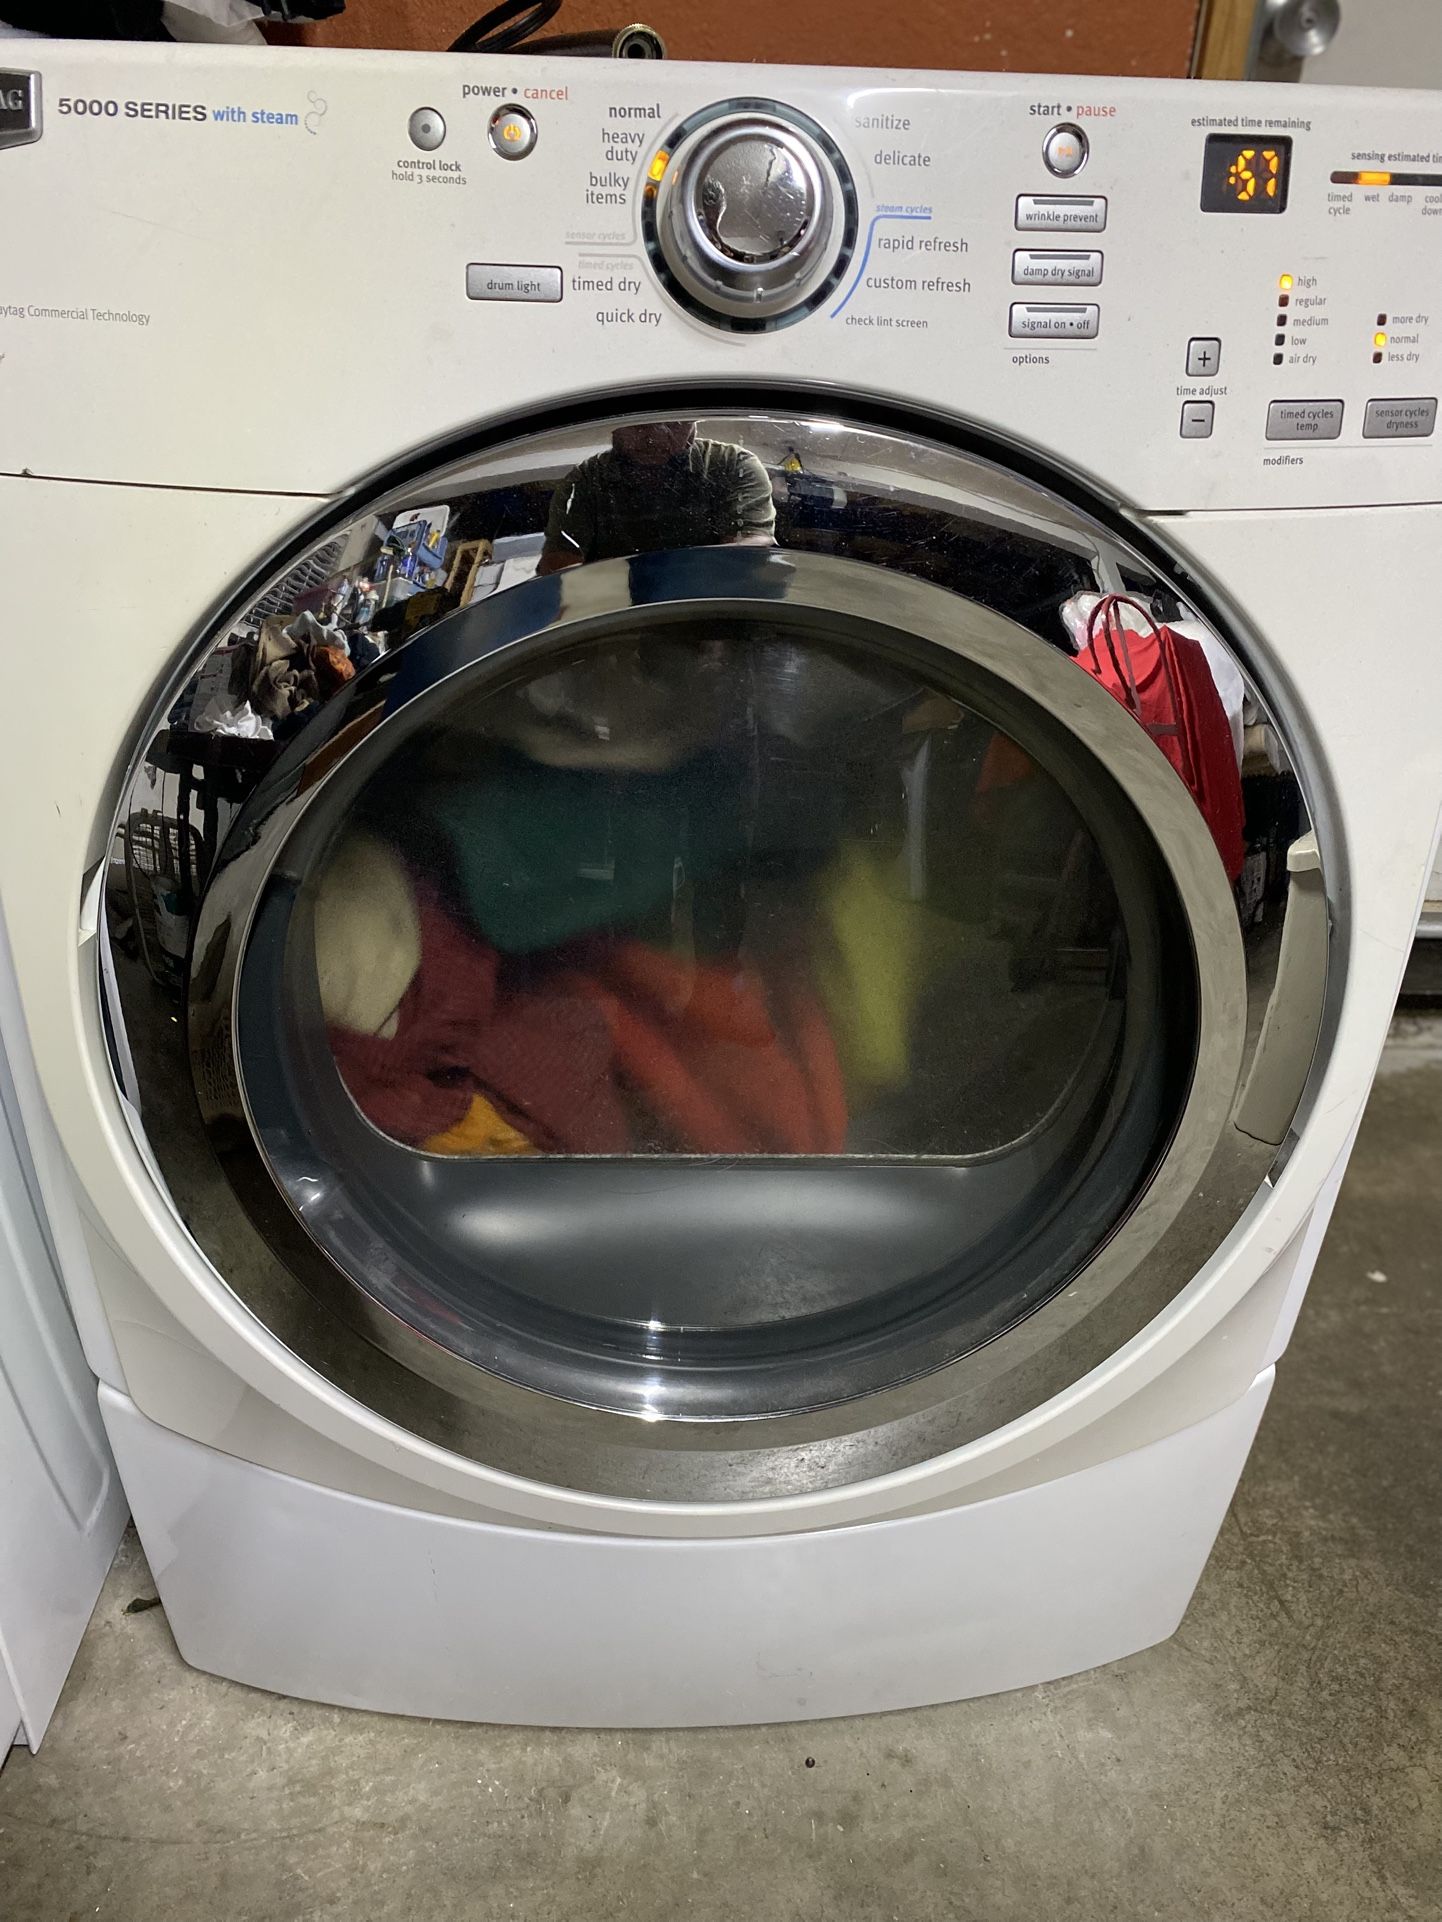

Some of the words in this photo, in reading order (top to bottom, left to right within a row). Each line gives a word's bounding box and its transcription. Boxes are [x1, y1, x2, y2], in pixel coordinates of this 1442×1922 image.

[462, 84, 507, 98] power
[524, 86, 568, 100] cancel
[57, 98, 118, 116] 5000
[124, 101, 207, 121] SERIES
[212, 107, 246, 123] with
[251, 109, 298, 125] steam
[609, 103, 661, 119] normal
[1029, 103, 1062, 116] start
[1076, 105, 1116, 119] pause
[855, 114, 911, 130] sanitize
[1191, 116, 1238, 127] estimated
[1241, 117, 1262, 128] time
[1265, 118, 1312, 131] remaining
[602, 128, 645, 147] heavy
[605, 147, 638, 164] duty
[874, 150, 931, 166] delicate
[1351, 151, 1385, 163] sensing
[1387, 152, 1430, 163] estimated
[397, 159, 436, 170] control
[438, 160, 462, 172] lock
[392, 170, 414, 181] hold
[417, 174, 423, 184] 3
[426, 174, 467, 185] seconds
[589, 172, 629, 190] bulky
[585, 189, 626, 205] items
[1327, 193, 1353, 203] timed
[1364, 193, 1380, 202] wet
[1388, 192, 1413, 205] damp
[876, 204, 903, 213] steam
[905, 204, 933, 214] cycles
[1328, 206, 1351, 216] cycle
[1026, 211, 1061, 222] wrinkle
[1063, 213, 1098, 224] prevent
[565, 231, 596, 240] sensor
[598, 232, 626, 241] cycles
[878, 235, 914, 252] rapid
[919, 236, 969, 252] refresh
[578, 260, 605, 269] timed
[606, 261, 634, 272] cycles
[1023, 266, 1049, 278] damp
[1051, 266, 1066, 279] dry
[1067, 267, 1094, 279] signal
[487, 279, 514, 291] drum
[517, 280, 541, 294] light
[572, 277, 613, 291] timed
[618, 277, 641, 295] dry
[866, 276, 917, 290] custom
[921, 277, 971, 293] refresh
[1297, 276, 1317, 288] high
[1295, 296, 1327, 308] regular
[27, 304, 88, 320] Commercial
[91, 308, 150, 326] Technology
[596, 309, 635, 325] quick
[639, 310, 662, 327] dry
[1293, 316, 1329, 327] medium
[1392, 316, 1413, 325] more
[1415, 314, 1429, 326] dry
[845, 315, 874, 326] check
[876, 316, 893, 327] lint
[895, 318, 928, 329] screen
[1022, 318, 1052, 331] signal
[1054, 321, 1066, 329] on
[1076, 320, 1090, 330] off
[1291, 336, 1307, 346] low
[1390, 334, 1419, 344] normal
[1012, 354, 1050, 366] options
[1289, 354, 1301, 364] air
[1303, 353, 1317, 366] dry
[1388, 351, 1404, 362] less
[1406, 351, 1420, 363] dry
[1176, 386, 1197, 396] time
[1198, 386, 1227, 397] adjust
[1280, 408, 1306, 419] timed
[1307, 408, 1334, 421] cycles
[1375, 408, 1403, 418] sensor
[1405, 407, 1430, 419] cycles
[1296, 421, 1319, 433] temp
[1387, 419, 1419, 430] dryness
[1263, 455, 1304, 466] modifiers
